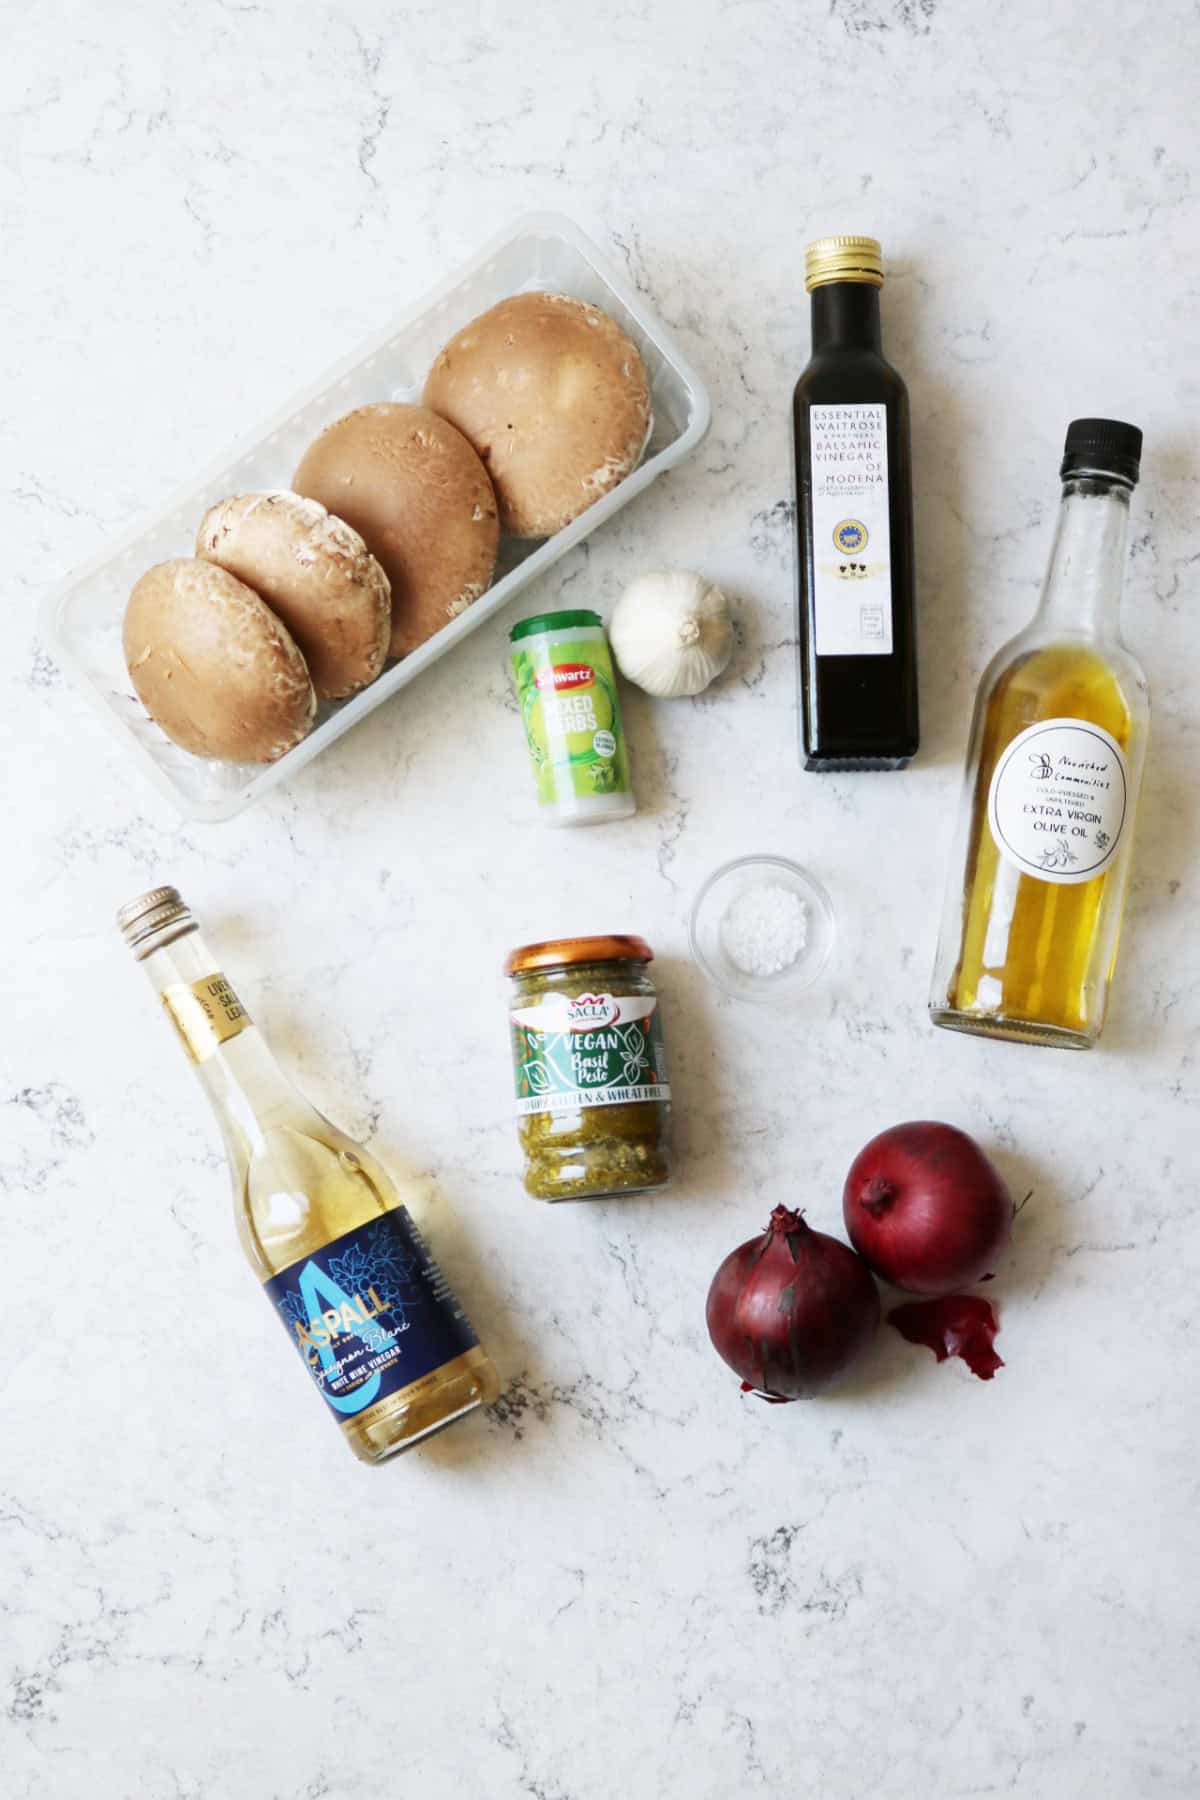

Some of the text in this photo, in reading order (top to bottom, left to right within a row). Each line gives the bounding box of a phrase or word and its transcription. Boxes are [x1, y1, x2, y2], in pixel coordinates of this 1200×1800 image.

[814, 410, 881, 419] ESSENTIAL
[815, 421, 881, 431] WAITROSE
[816, 440, 881, 450] BALSAMIC
[815, 452, 873, 461] VINEGAR
[866, 463, 880, 472] OF
[826, 474, 883, 483] MODENA
[536, 670, 592, 687] Shwartz
[1023, 804, 1102, 824] EXTRA VIRGIN
[1033, 821, 1088, 838] OLIVE OIL
[563, 1033, 618, 1050] VEGAN
[571, 1052, 609, 1071] Basil
[577, 1070, 609, 1084] Pesto
[595, 1092, 606, 1103] &
[607, 1088, 644, 1101] WHEAT
[295, 1287, 391, 1350] ASPALL
[362, 1321, 411, 1352] Blanc
[349, 1364, 369, 1381] WINE
[368, 1346, 402, 1371] VINEGAR
